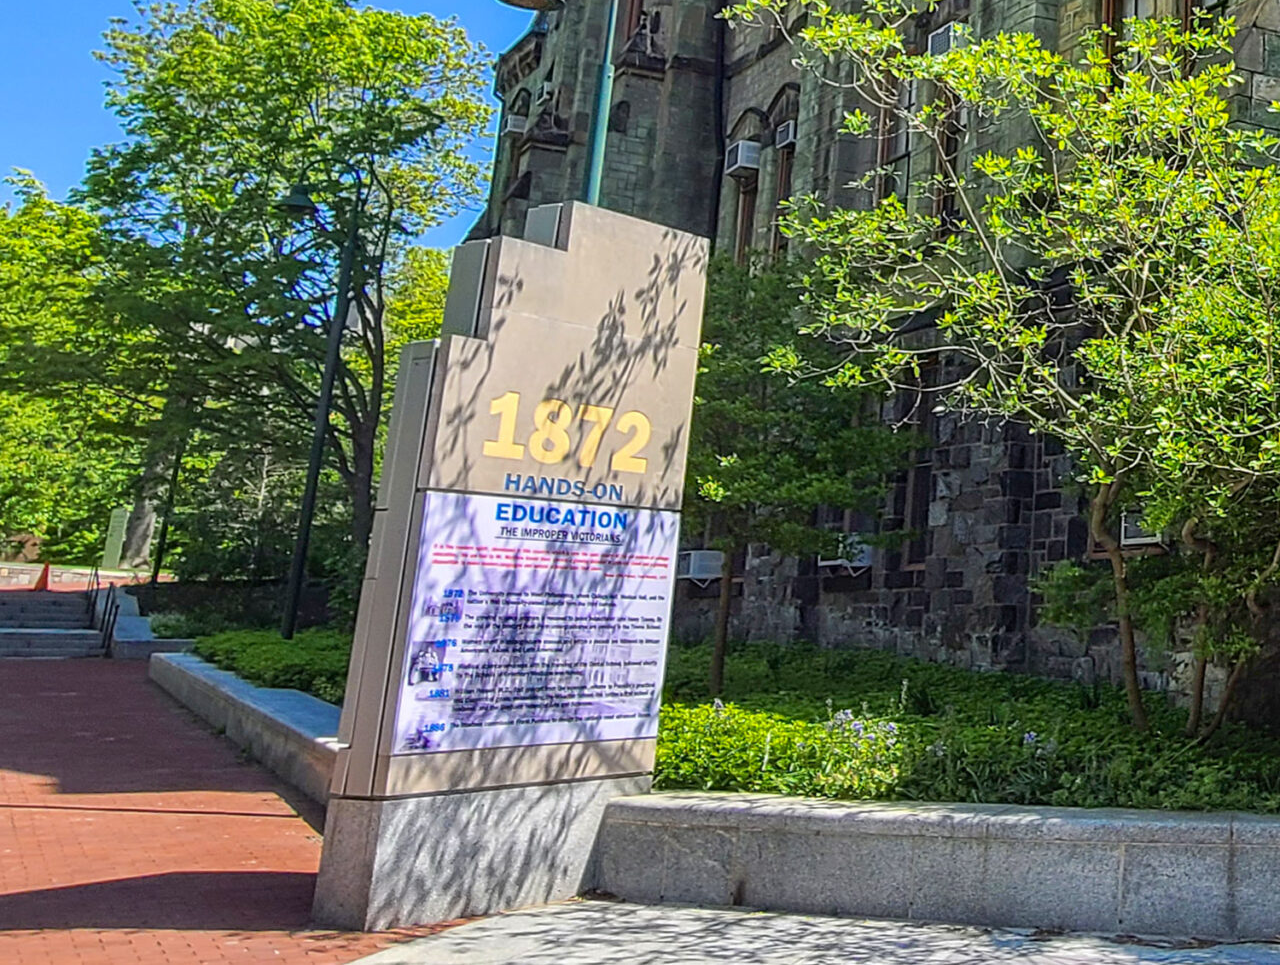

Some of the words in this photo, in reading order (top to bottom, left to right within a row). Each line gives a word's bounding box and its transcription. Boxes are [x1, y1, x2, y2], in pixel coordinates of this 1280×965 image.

[482, 390, 652, 474] 1872
[504, 472, 624, 501] HANDS-ON
[495, 502, 628, 530] EDUCATION
[500, 526, 518, 537] THE
[520, 528, 568, 541] IMPROPER
[570, 531, 621, 544] VICTORIANS
